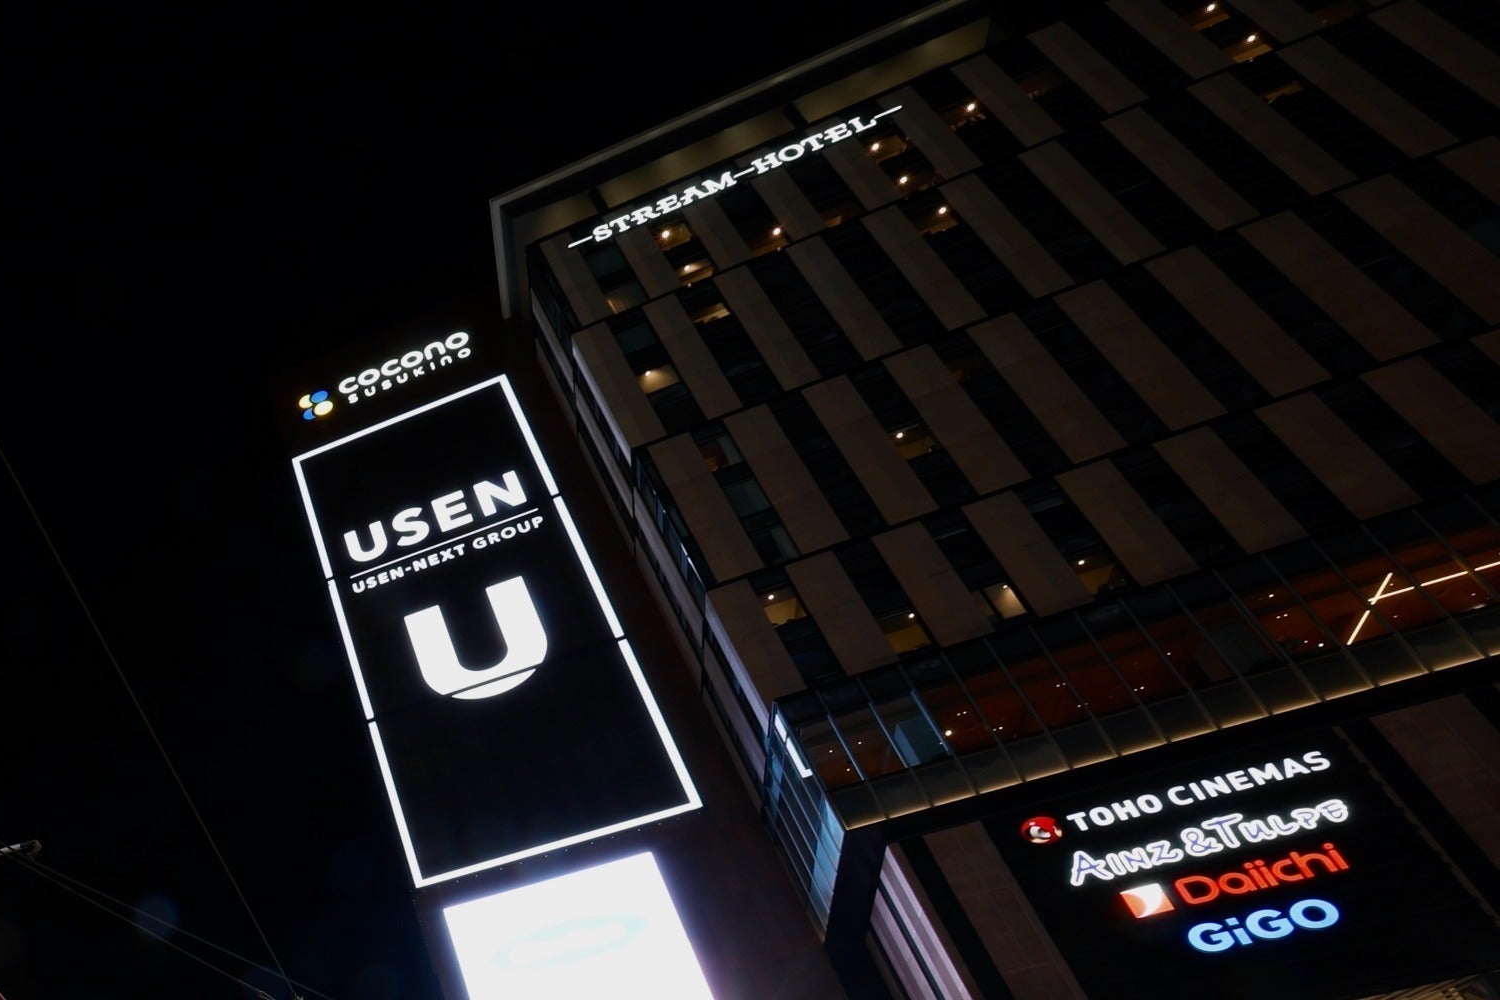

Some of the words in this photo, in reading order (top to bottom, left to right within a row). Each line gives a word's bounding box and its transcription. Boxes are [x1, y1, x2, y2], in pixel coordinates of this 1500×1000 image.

[343, 470, 528, 562] USEN
[351, 544, 465, 594] USEN-NEXT
[472, 515, 544, 550] GROUP
[1066, 793, 1164, 833] TOHO
[1167, 750, 1332, 807] CINEMAS
[1173, 842, 1351, 905] Daiichi
[1187, 898, 1341, 953] GiGO
